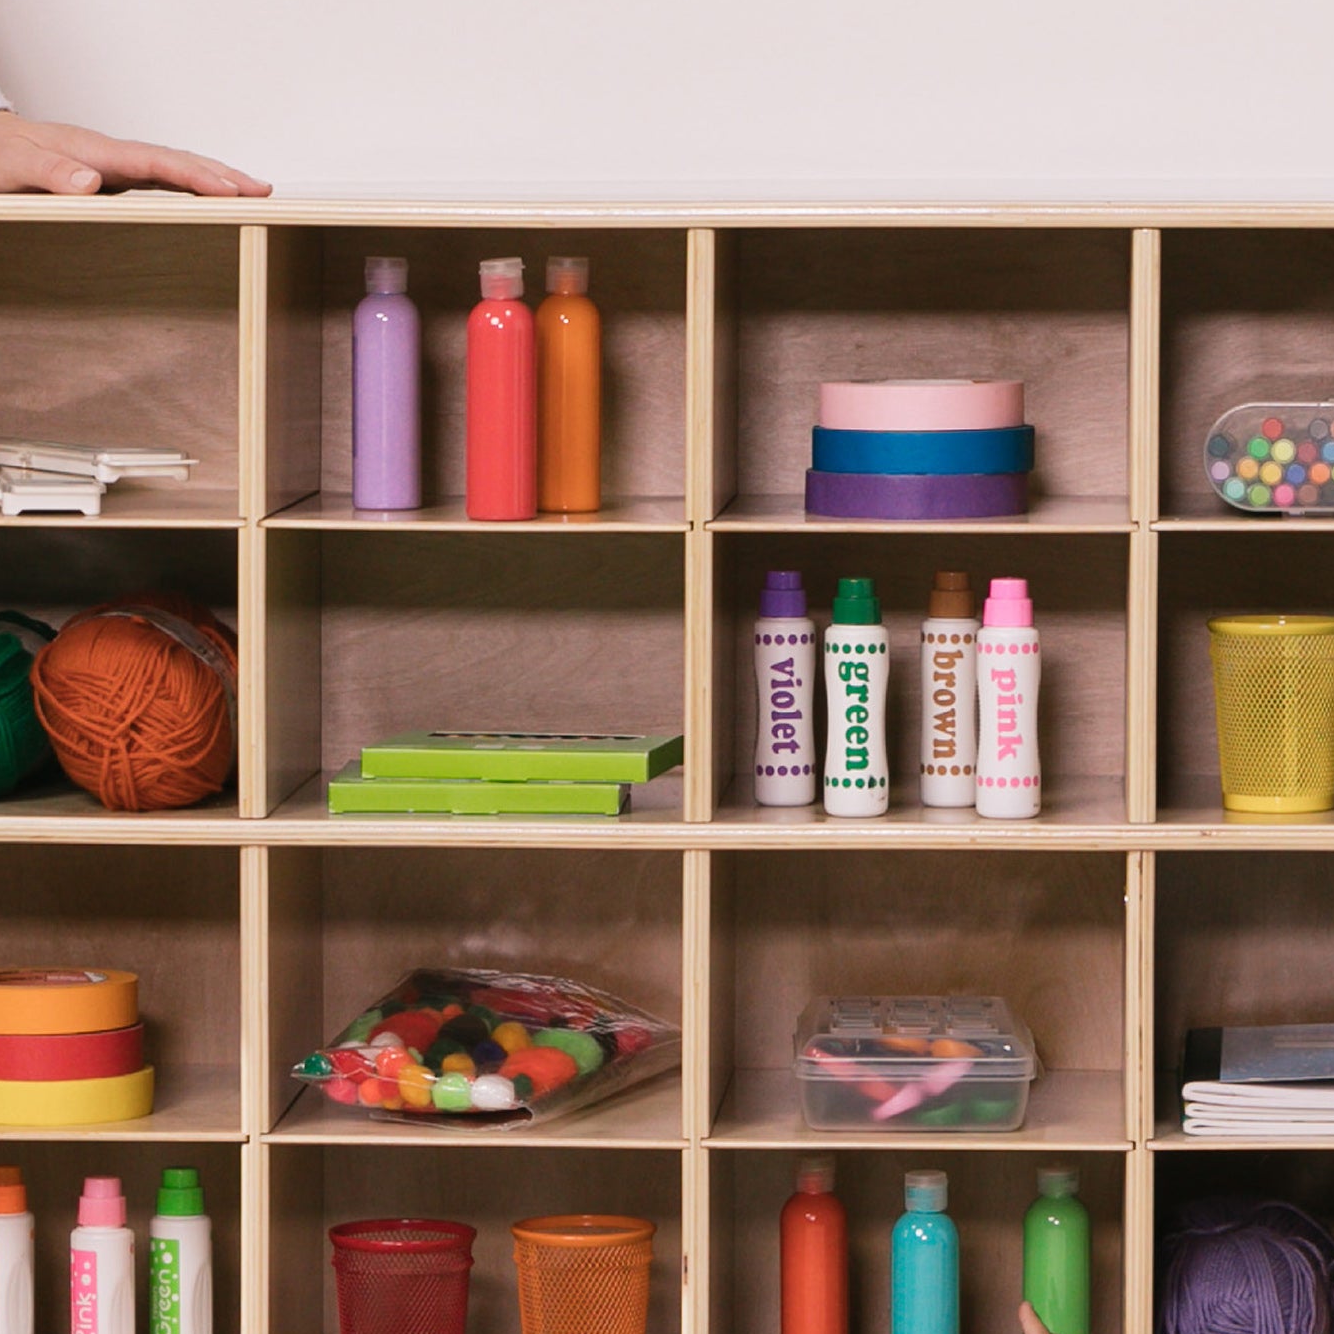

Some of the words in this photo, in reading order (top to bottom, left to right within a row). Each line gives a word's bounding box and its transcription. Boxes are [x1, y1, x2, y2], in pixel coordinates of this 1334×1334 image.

[770, 657, 803, 755] violet
[838, 661, 870, 771] green
[933, 649, 964, 759] brown
[991, 667, 1024, 761] pink
